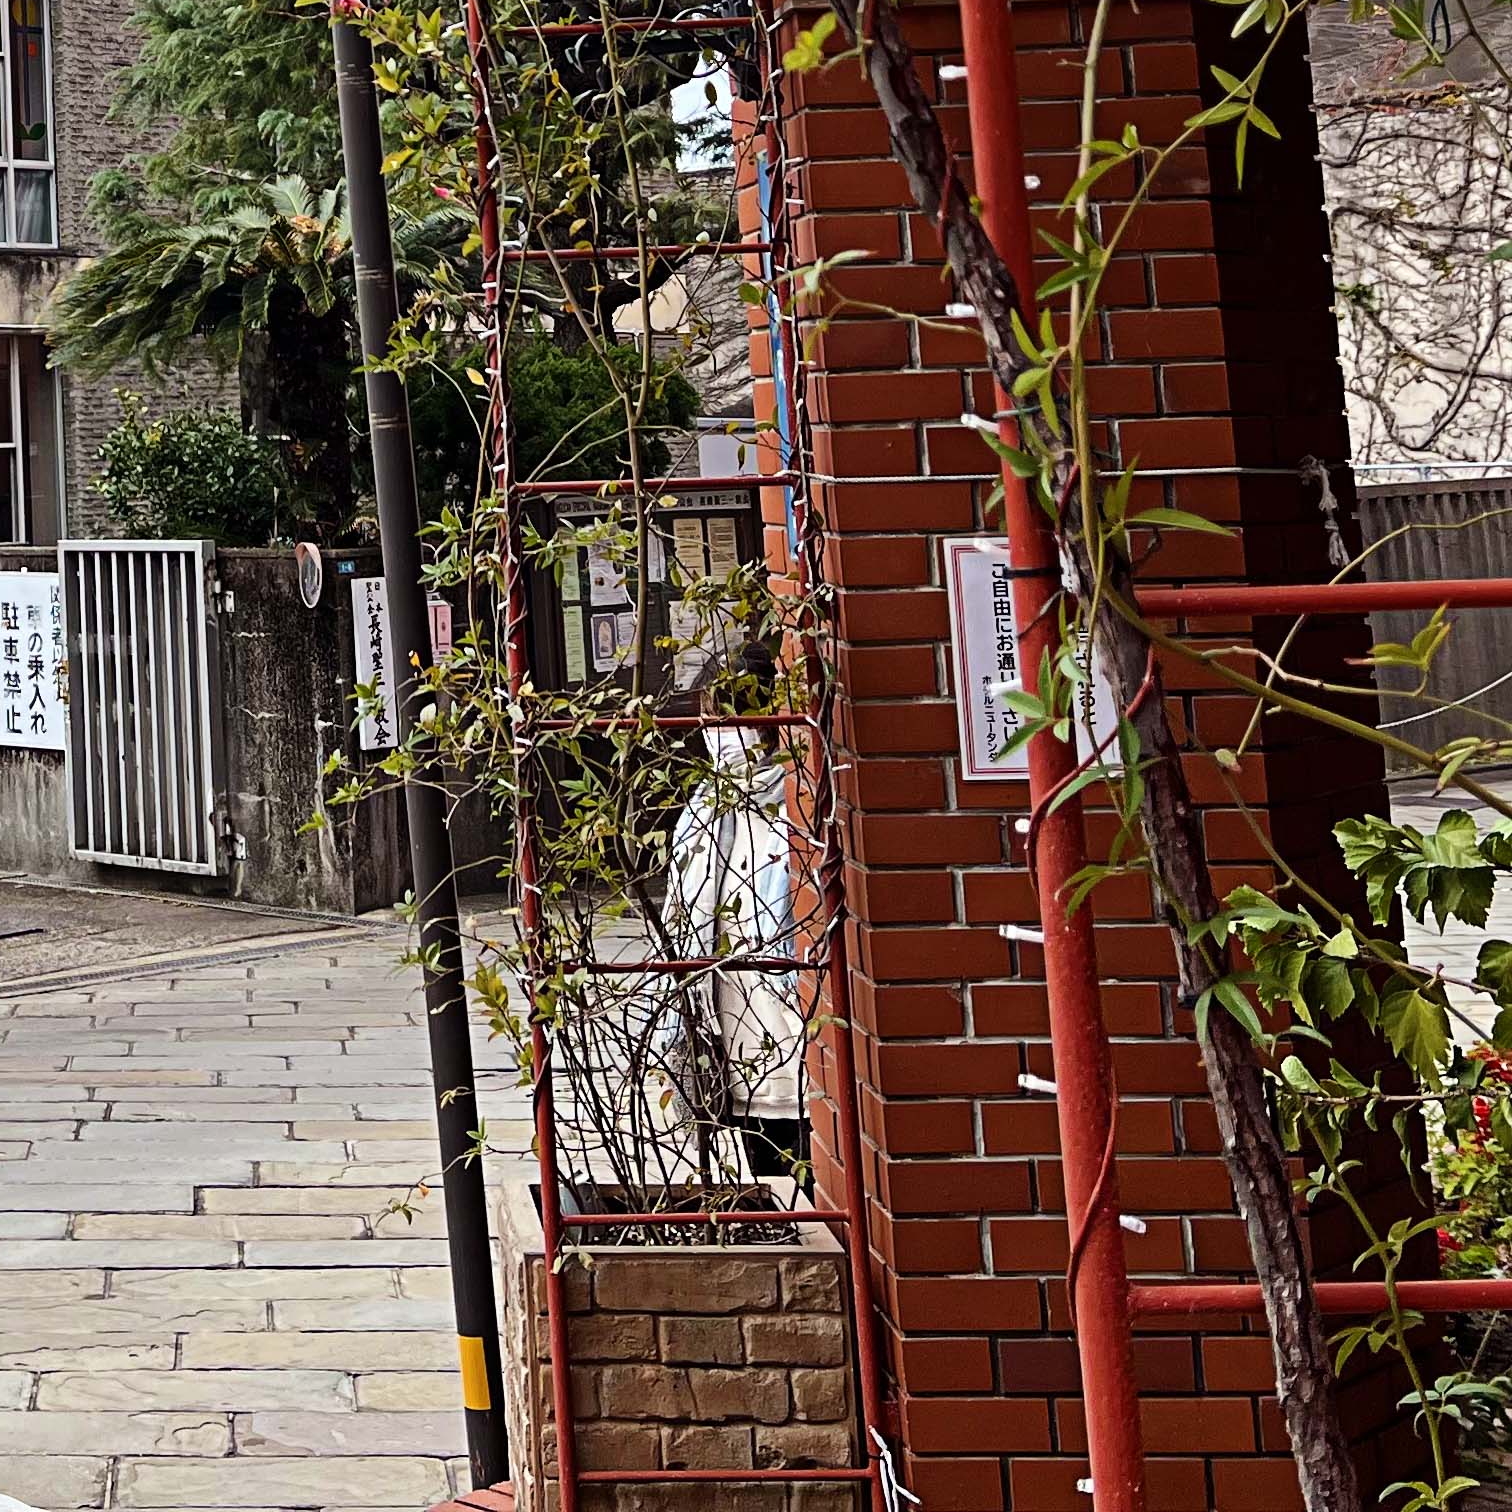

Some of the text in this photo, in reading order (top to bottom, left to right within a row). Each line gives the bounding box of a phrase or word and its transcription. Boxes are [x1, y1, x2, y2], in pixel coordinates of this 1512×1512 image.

[1, 602, 23, 734] 駐車禁止
[368, 614, 392, 746] 長崎聖三教会
[992, 563, 1019, 744] ご自由にお通りさい
